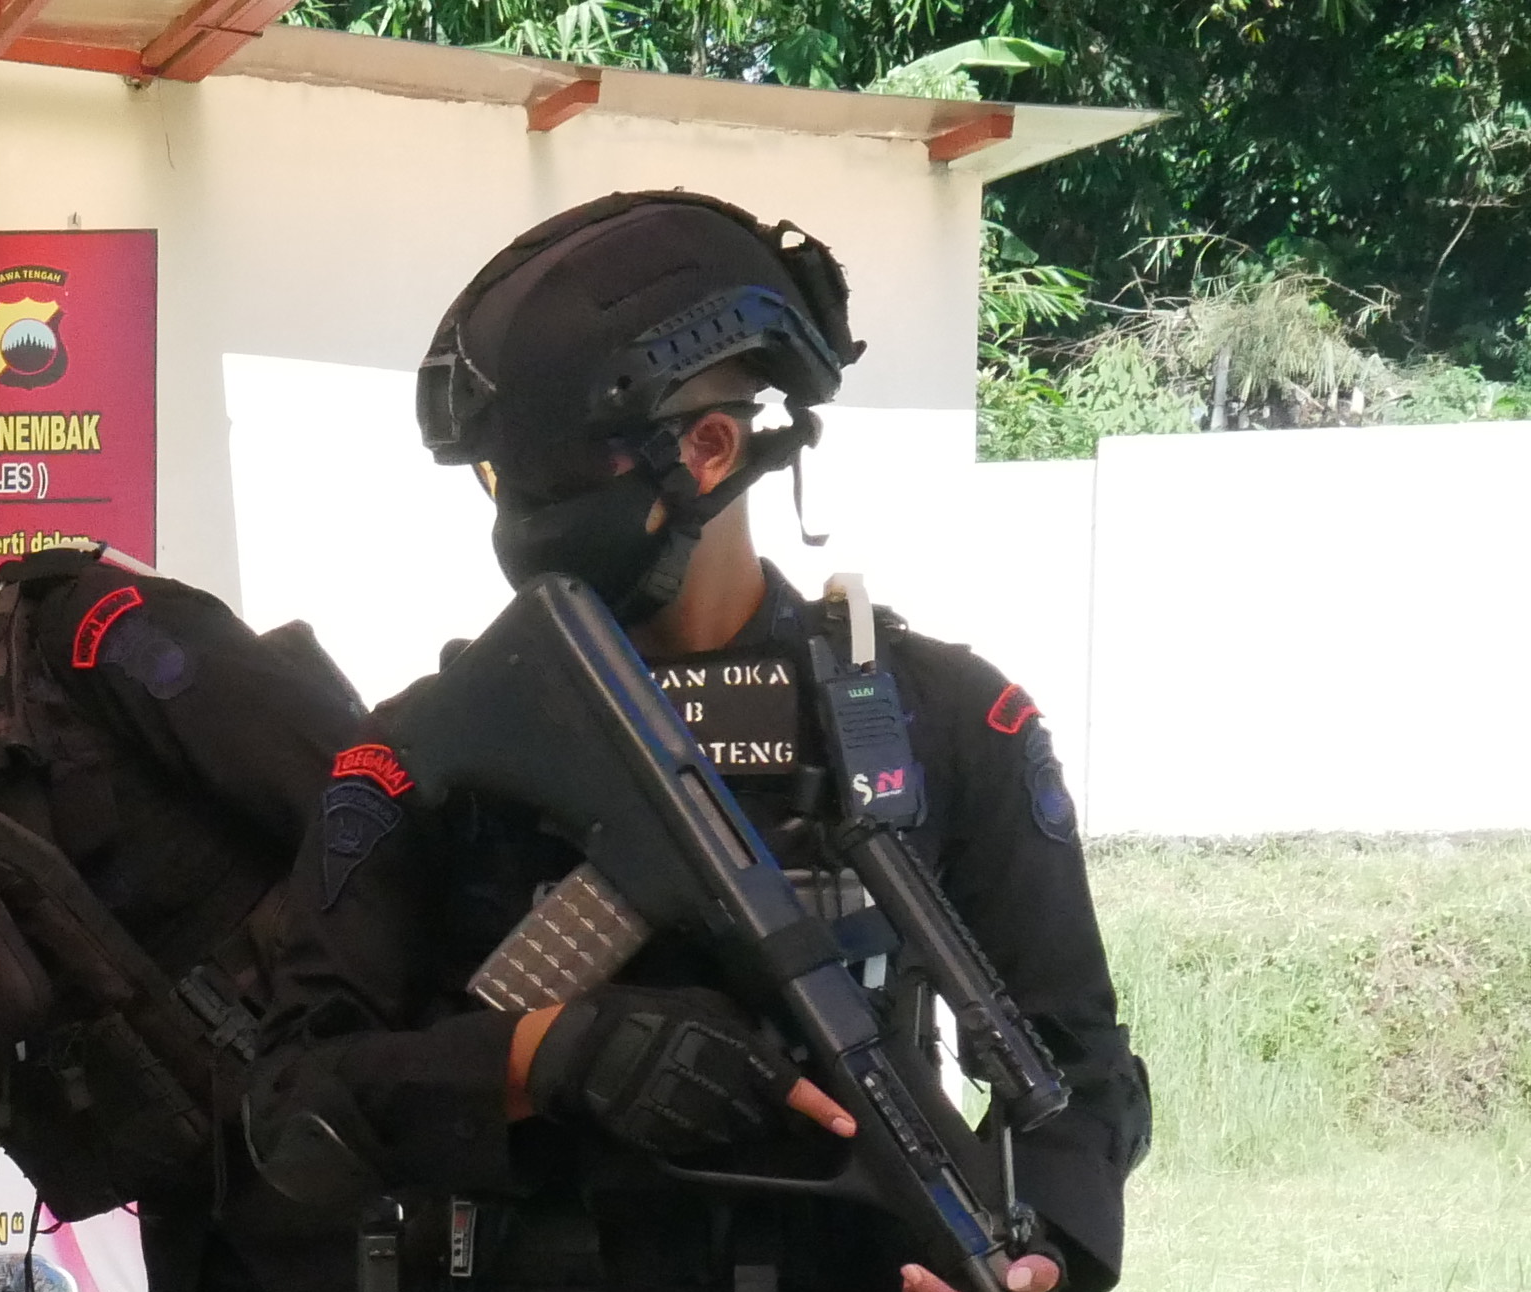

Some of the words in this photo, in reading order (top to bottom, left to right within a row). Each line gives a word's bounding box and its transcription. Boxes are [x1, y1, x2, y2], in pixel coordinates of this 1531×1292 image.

[23, 270, 61, 282] TENGAH
[648, 668, 707, 690] AN
[723, 664, 790, 685] OKA
[685, 702, 704, 722] B
